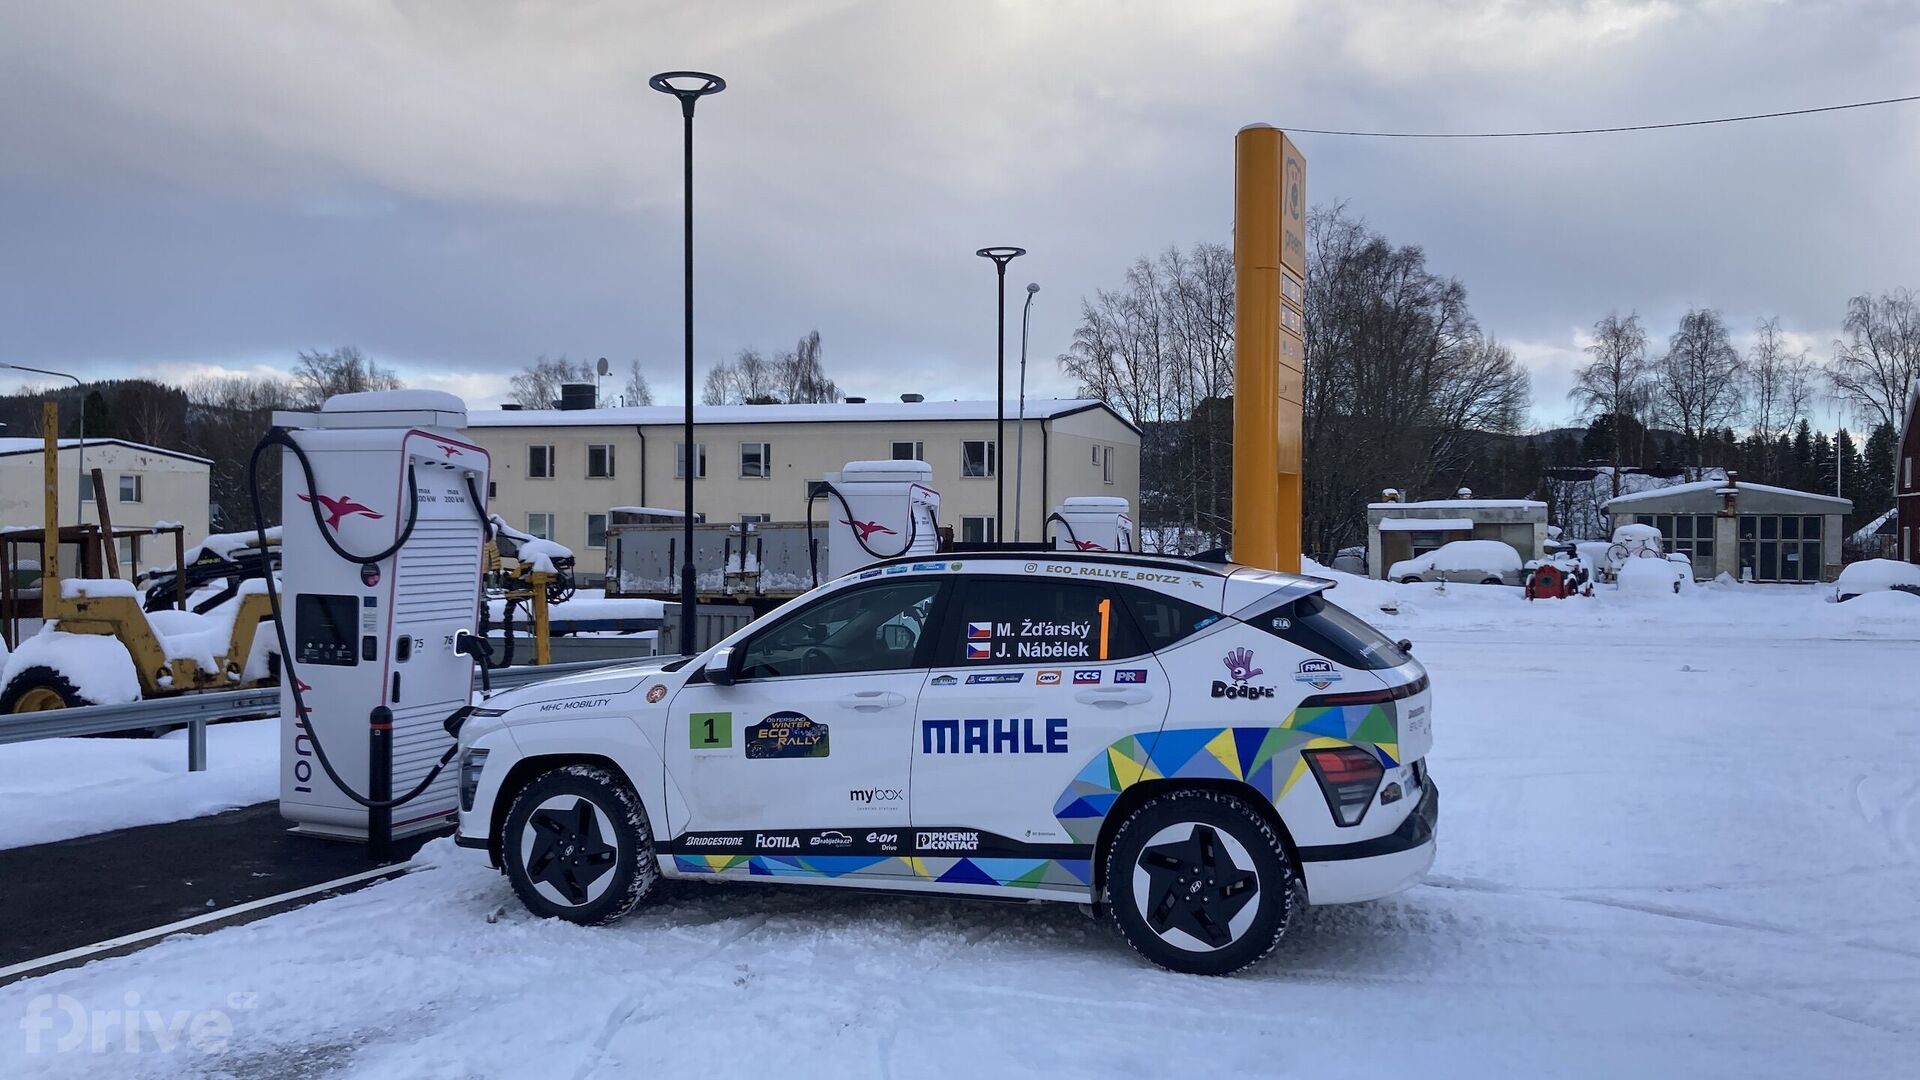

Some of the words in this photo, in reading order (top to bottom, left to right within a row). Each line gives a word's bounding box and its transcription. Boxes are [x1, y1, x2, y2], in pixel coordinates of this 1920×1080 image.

[1046, 564, 1181, 585] ECO_RALLYE_BOYZZ
[996, 623, 1015, 637] M.
[1020, 618, 1091, 639] Žďárský
[1098, 598, 1111, 660] 1
[414, 638, 424, 648] 75
[995, 642, 1011, 658] J.
[1017, 641, 1090, 658] Nábělek
[1305, 663, 1327, 672] FPAK
[1075, 671, 1100, 680] CCS
[540, 701, 562, 712] MHC
[564, 698, 611, 711] MOBILITY
[703, 718, 719, 743] 1
[771, 721, 811, 729] WINTER
[757, 728, 790, 739] ECO
[922, 718, 1069, 754] MAHLE
[777, 736, 821, 746] RALLY
[850, 786, 904, 803] mybox
[685, 836, 744, 846] BRIDGESTONE
[755, 833, 800, 848] FLOTILA
[931, 841, 979, 850] CONTACT
